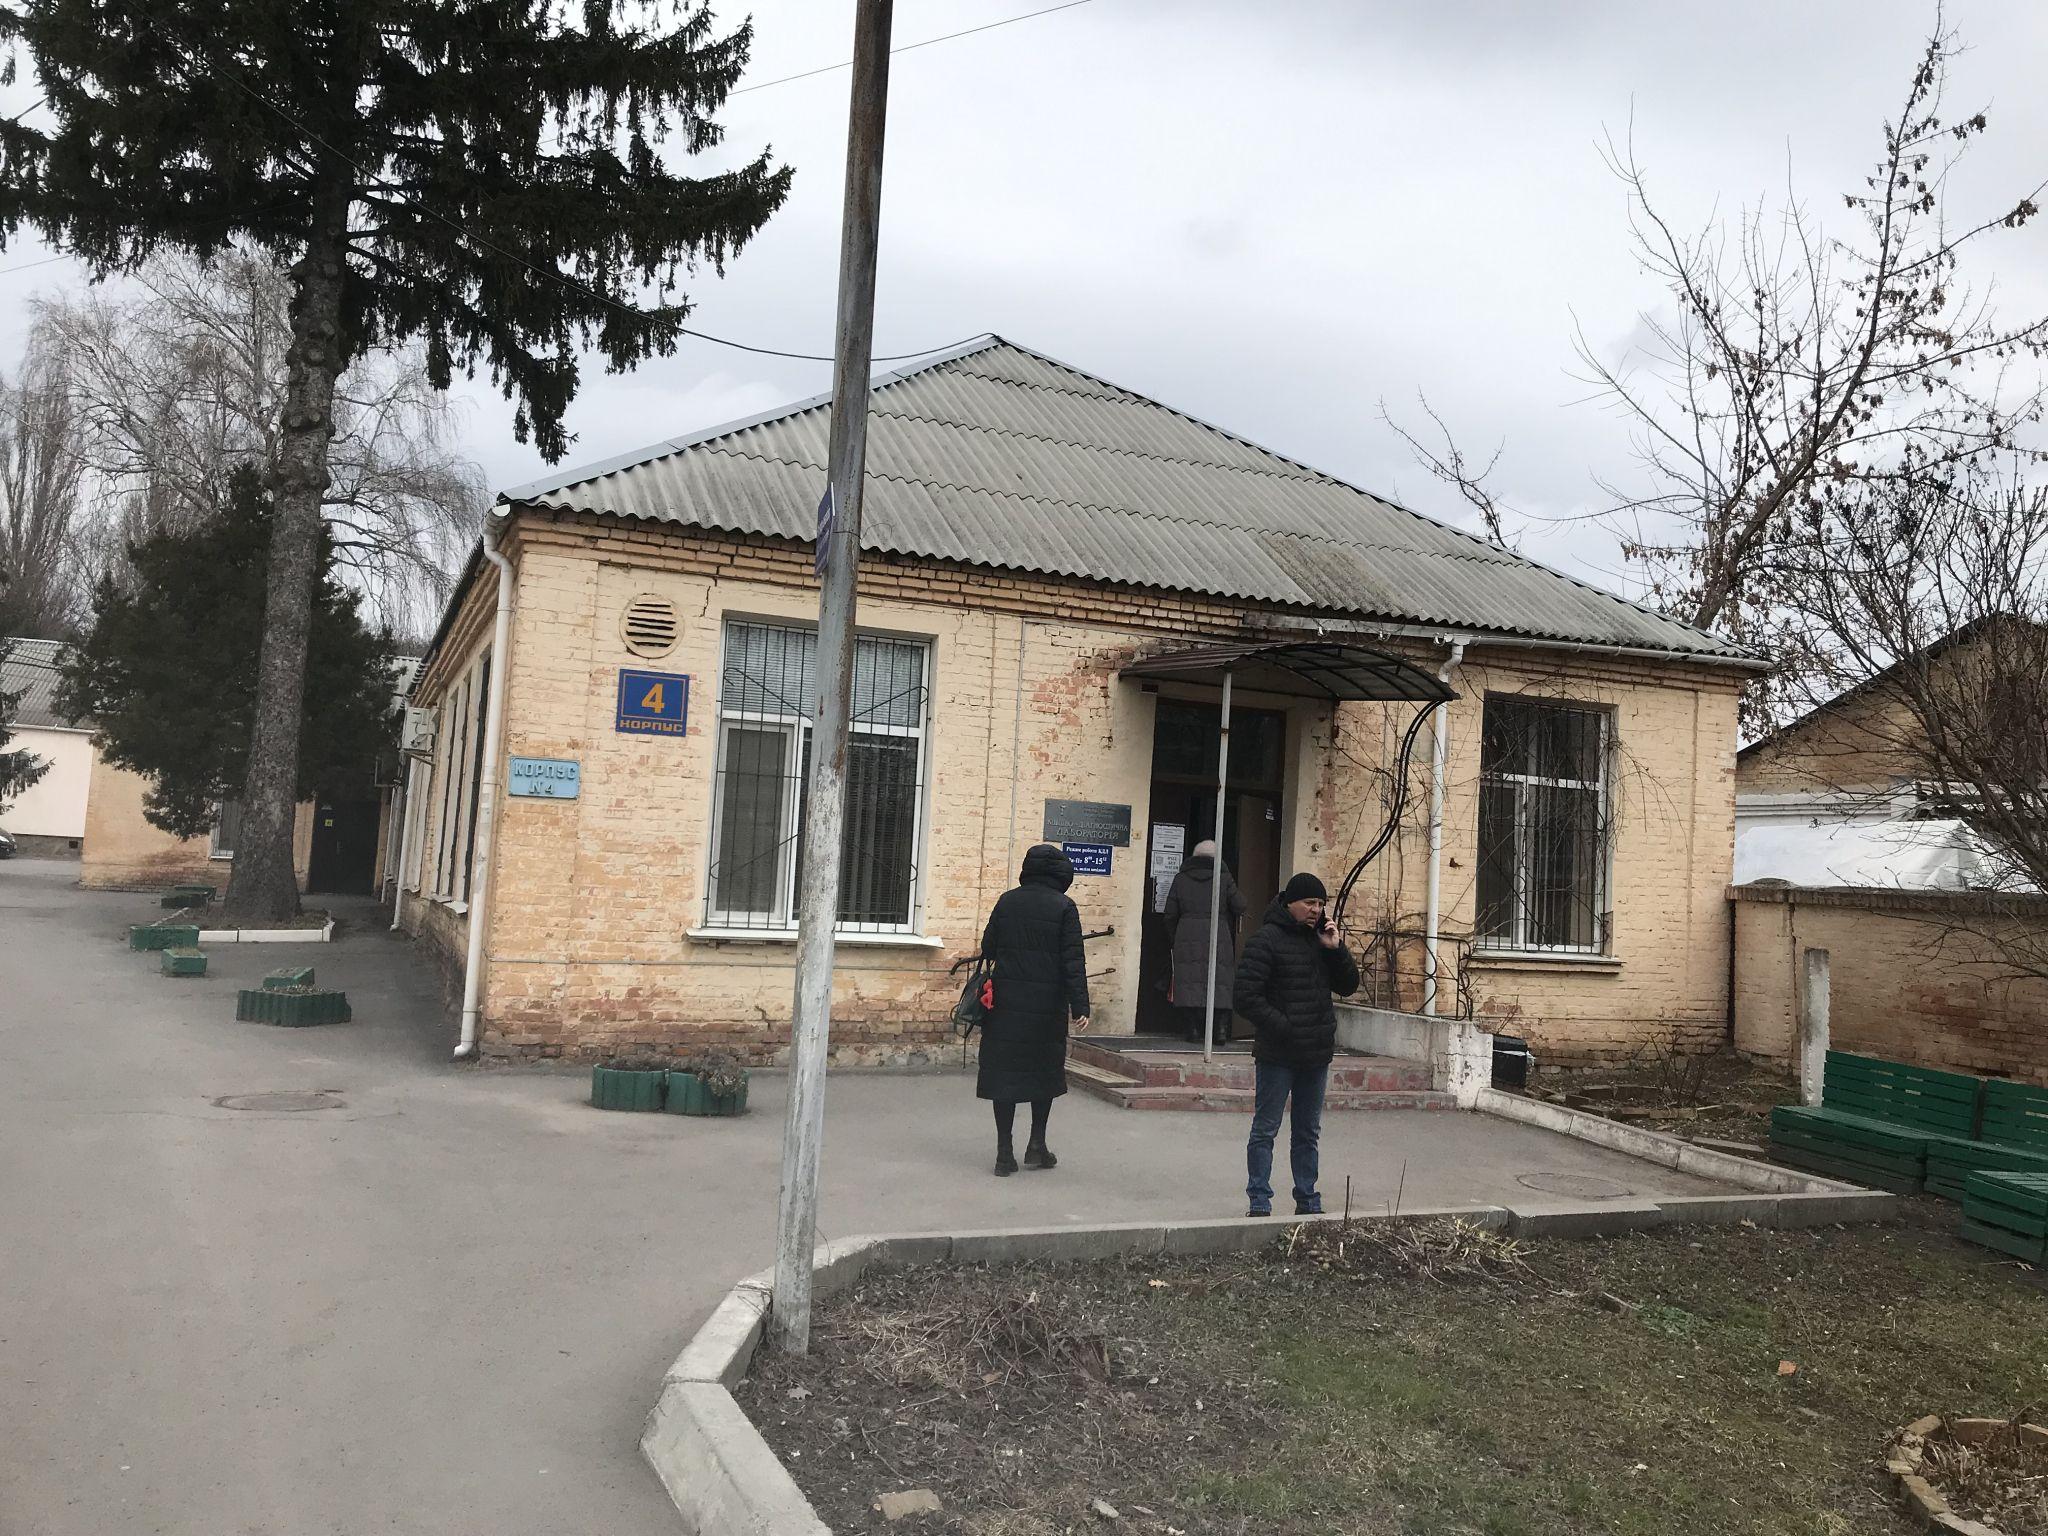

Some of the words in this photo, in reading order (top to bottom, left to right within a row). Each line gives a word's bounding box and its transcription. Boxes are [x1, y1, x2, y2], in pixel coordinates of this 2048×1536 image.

[641, 683, 665, 714] 4
[514, 762, 576, 779] КОРПУС
[545, 784, 554, 795] 4
[1056, 828, 1119, 840] ЛАБОРАТОРІЯ
